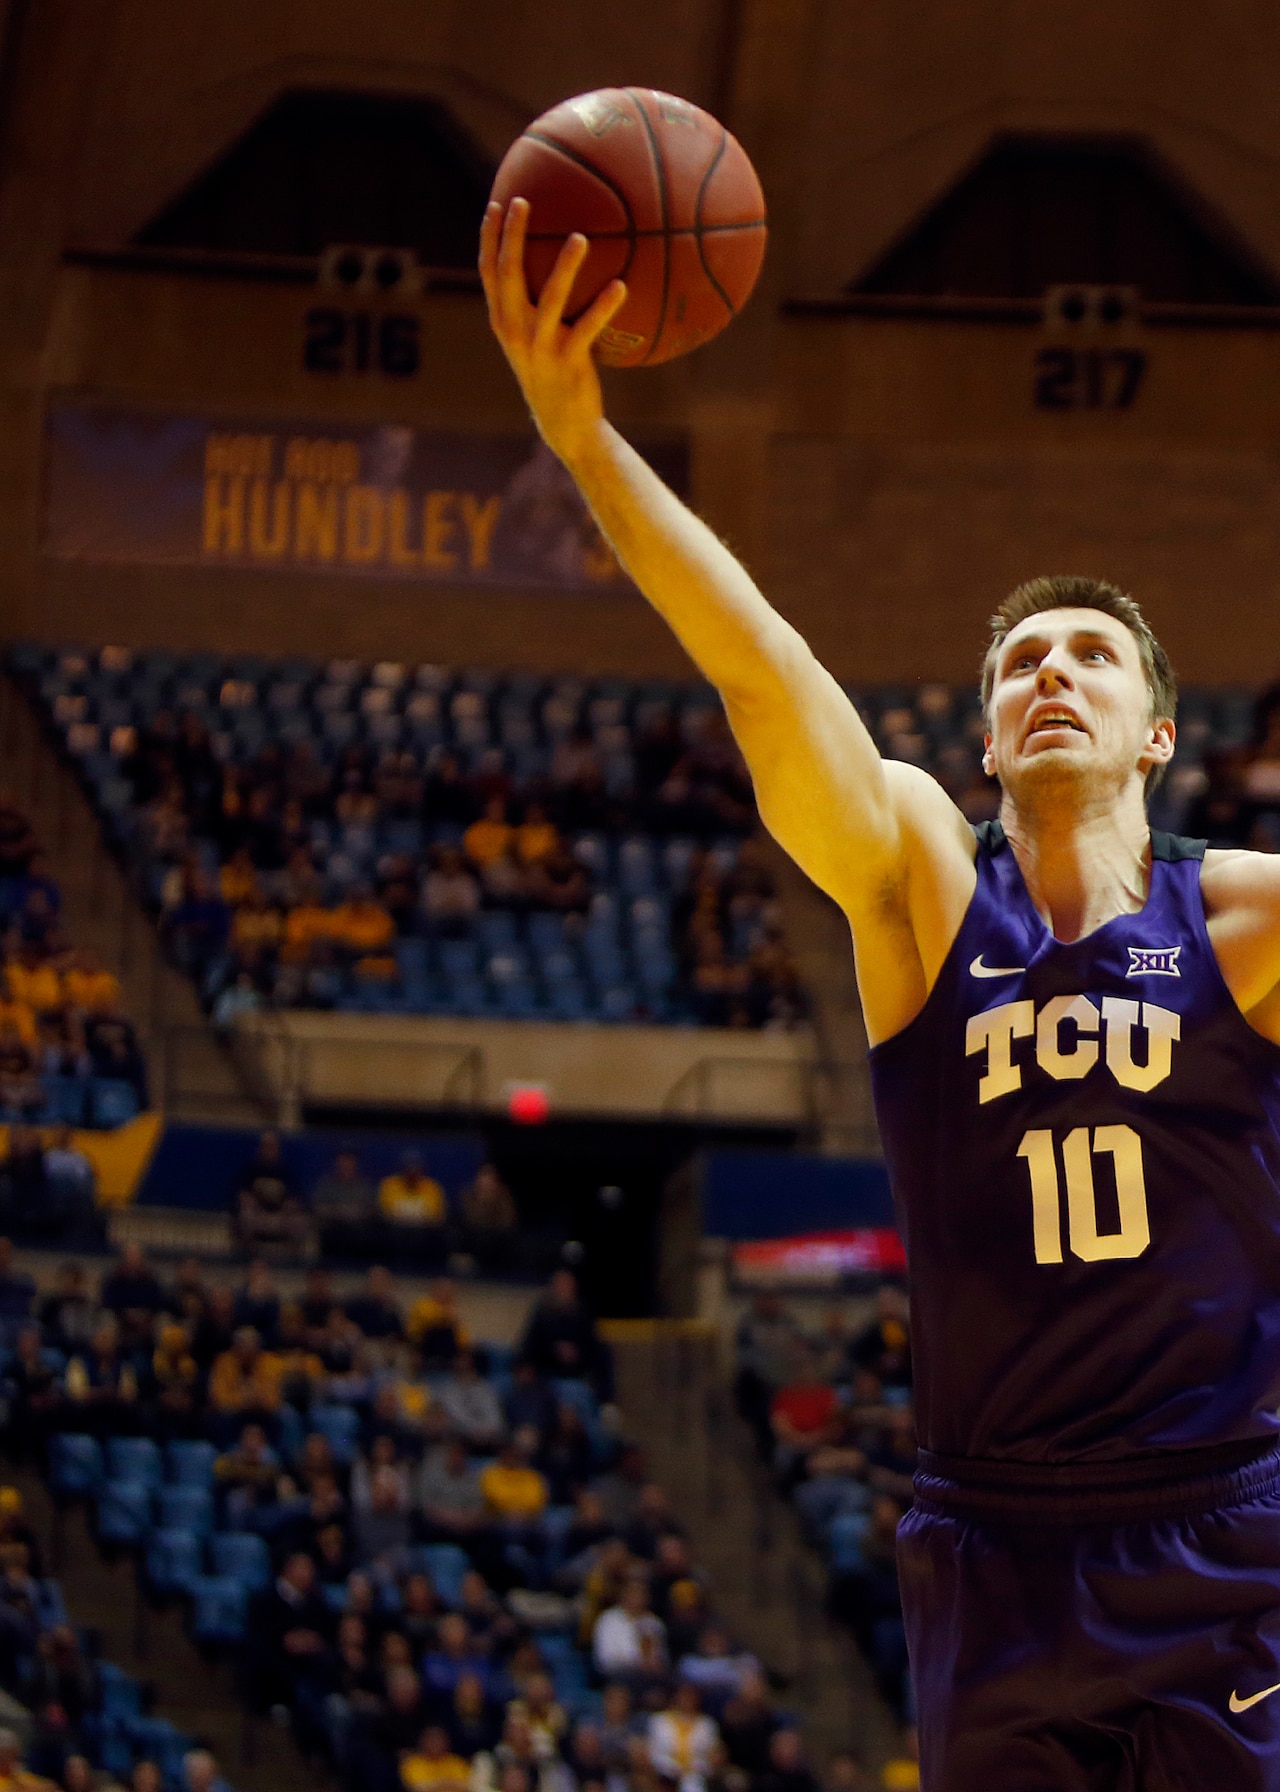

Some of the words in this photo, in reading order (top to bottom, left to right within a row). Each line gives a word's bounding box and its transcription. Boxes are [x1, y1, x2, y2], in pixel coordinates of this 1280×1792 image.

[305, 309, 420, 376] 216
[1036, 347, 1146, 410] 217
[203, 474, 500, 570] HUNDLEY
[965, 995, 1181, 1104] TCU
[1016, 1124, 1150, 1264] 10
